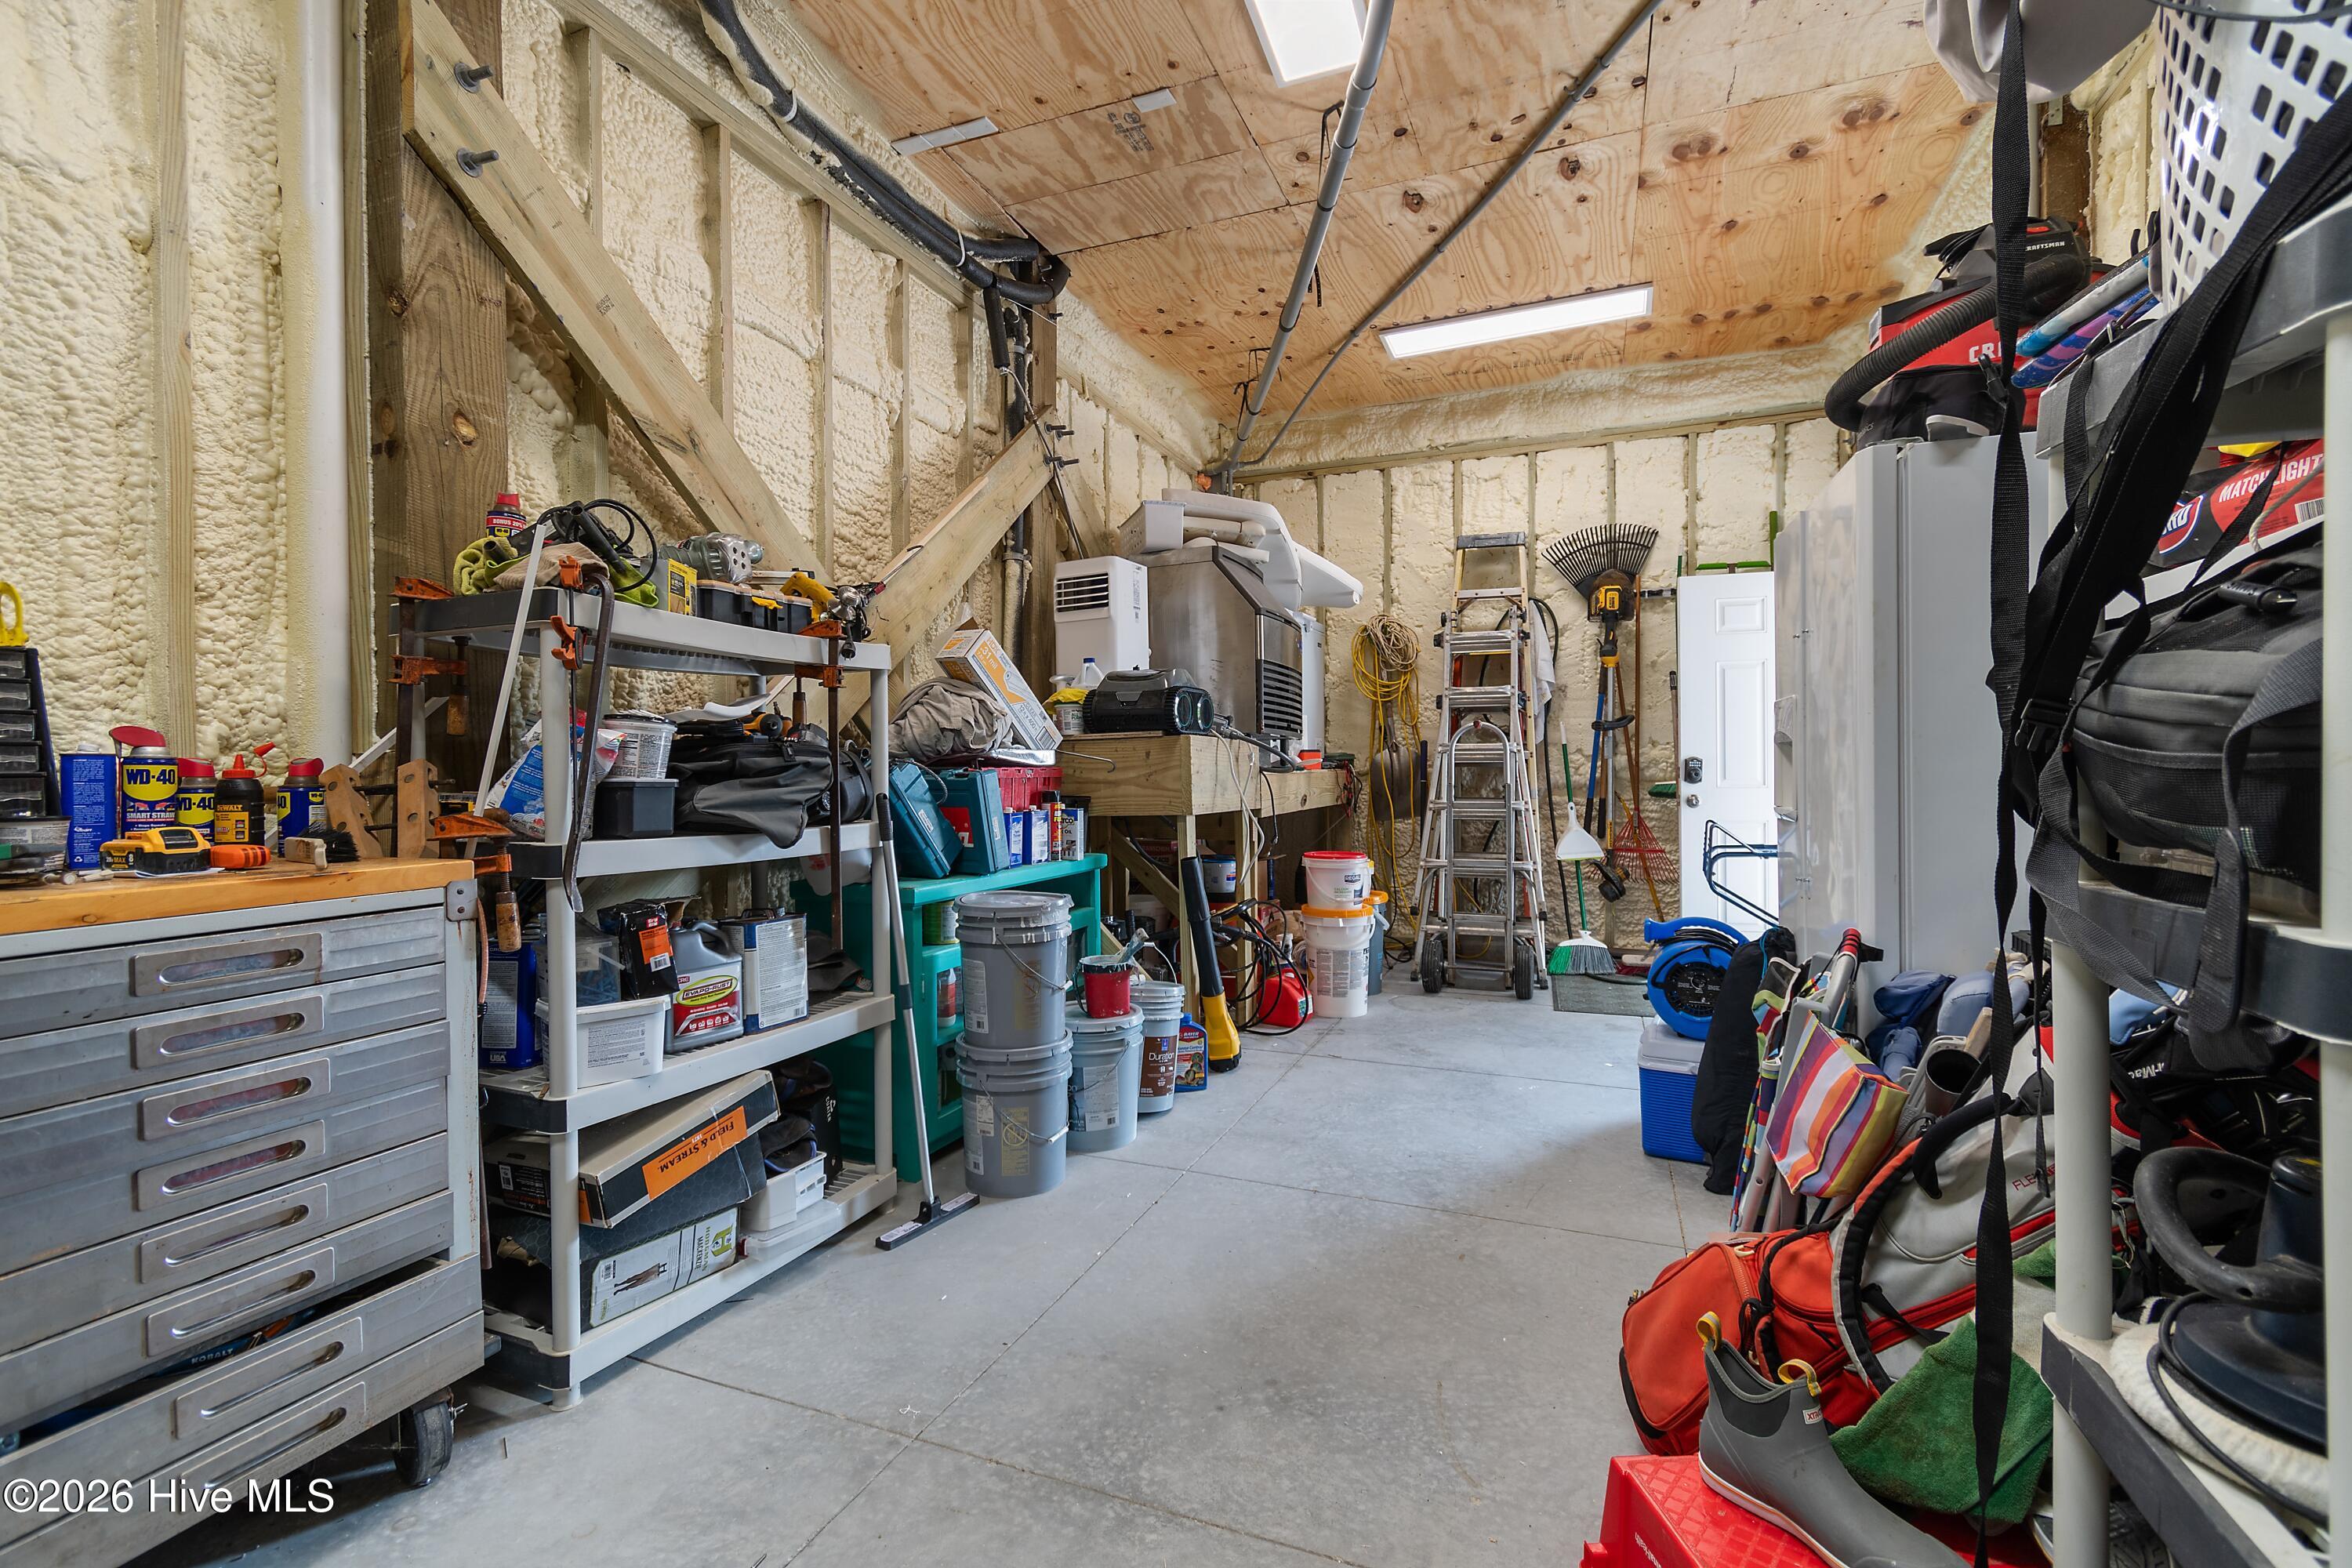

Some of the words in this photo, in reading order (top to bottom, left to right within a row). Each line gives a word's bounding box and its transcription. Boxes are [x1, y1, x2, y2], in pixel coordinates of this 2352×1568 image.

[2026, 241, 2065, 251] RAFTSMAN
[1969, 341, 2002, 363] CR
[126, 769, 175, 784] WD-40
[685, 982, 730, 997] EVAPO-RUST
[1149, 1052, 1174, 1061] Duration
[691, 1134, 702, 1143] 1871
[710, 1121, 735, 1142] FIELD
[700, 1139, 708, 1148] &
[660, 1142, 700, 1174] STREAM
[2013, 1174, 2037, 1191] FLE
[191, 1348, 233, 1364] KOBALT
[1635, 1532, 1661, 1568] inalHealth
